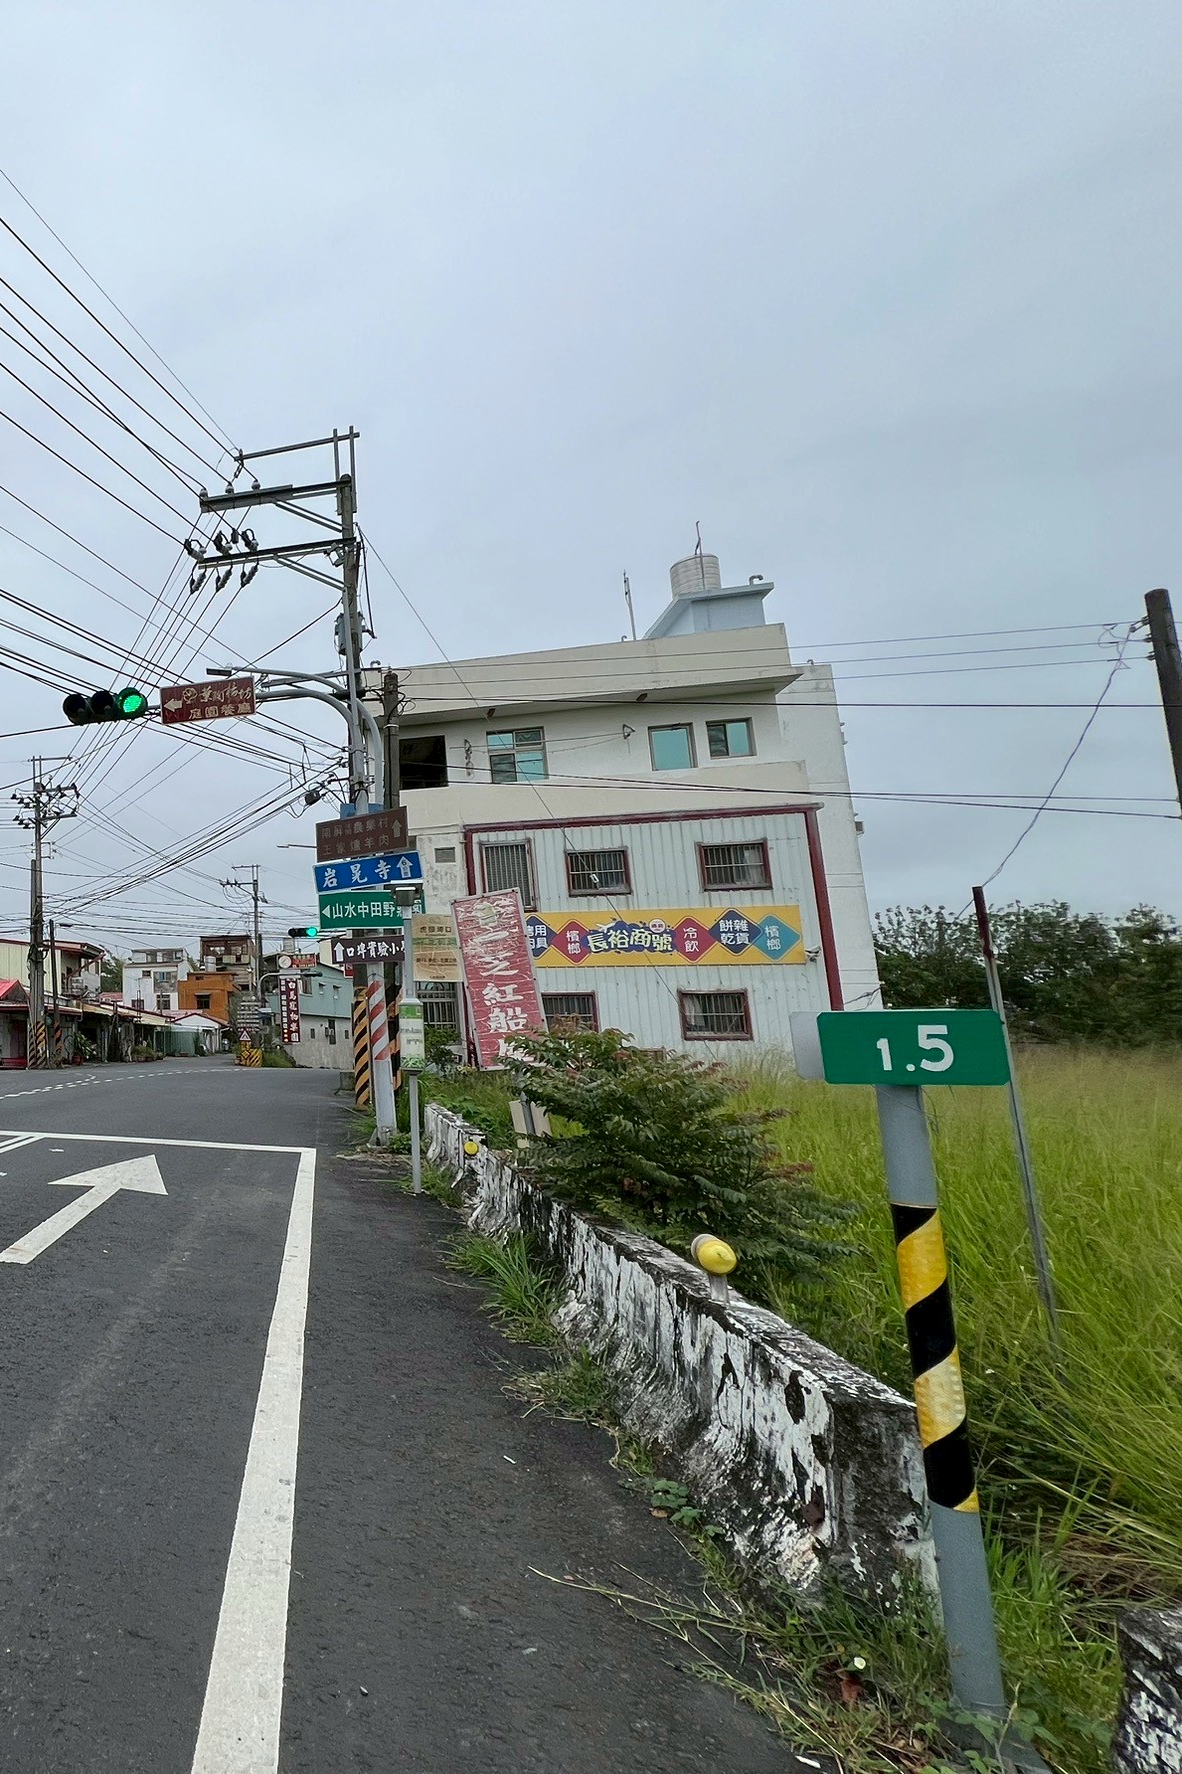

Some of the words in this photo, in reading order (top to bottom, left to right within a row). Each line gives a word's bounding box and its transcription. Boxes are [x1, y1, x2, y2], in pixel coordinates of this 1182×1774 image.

[322, 860, 392, 888] 岩晃寺
[346, 940, 406, 959] 口埤實驗小
[566, 930, 581, 955] 檳榔
[587, 928, 675, 953] 長裕商號
[683, 927, 700, 953] 冷飲
[764, 922, 782, 951] 檳榔
[876, 1024, 955, 1072] 1.5
